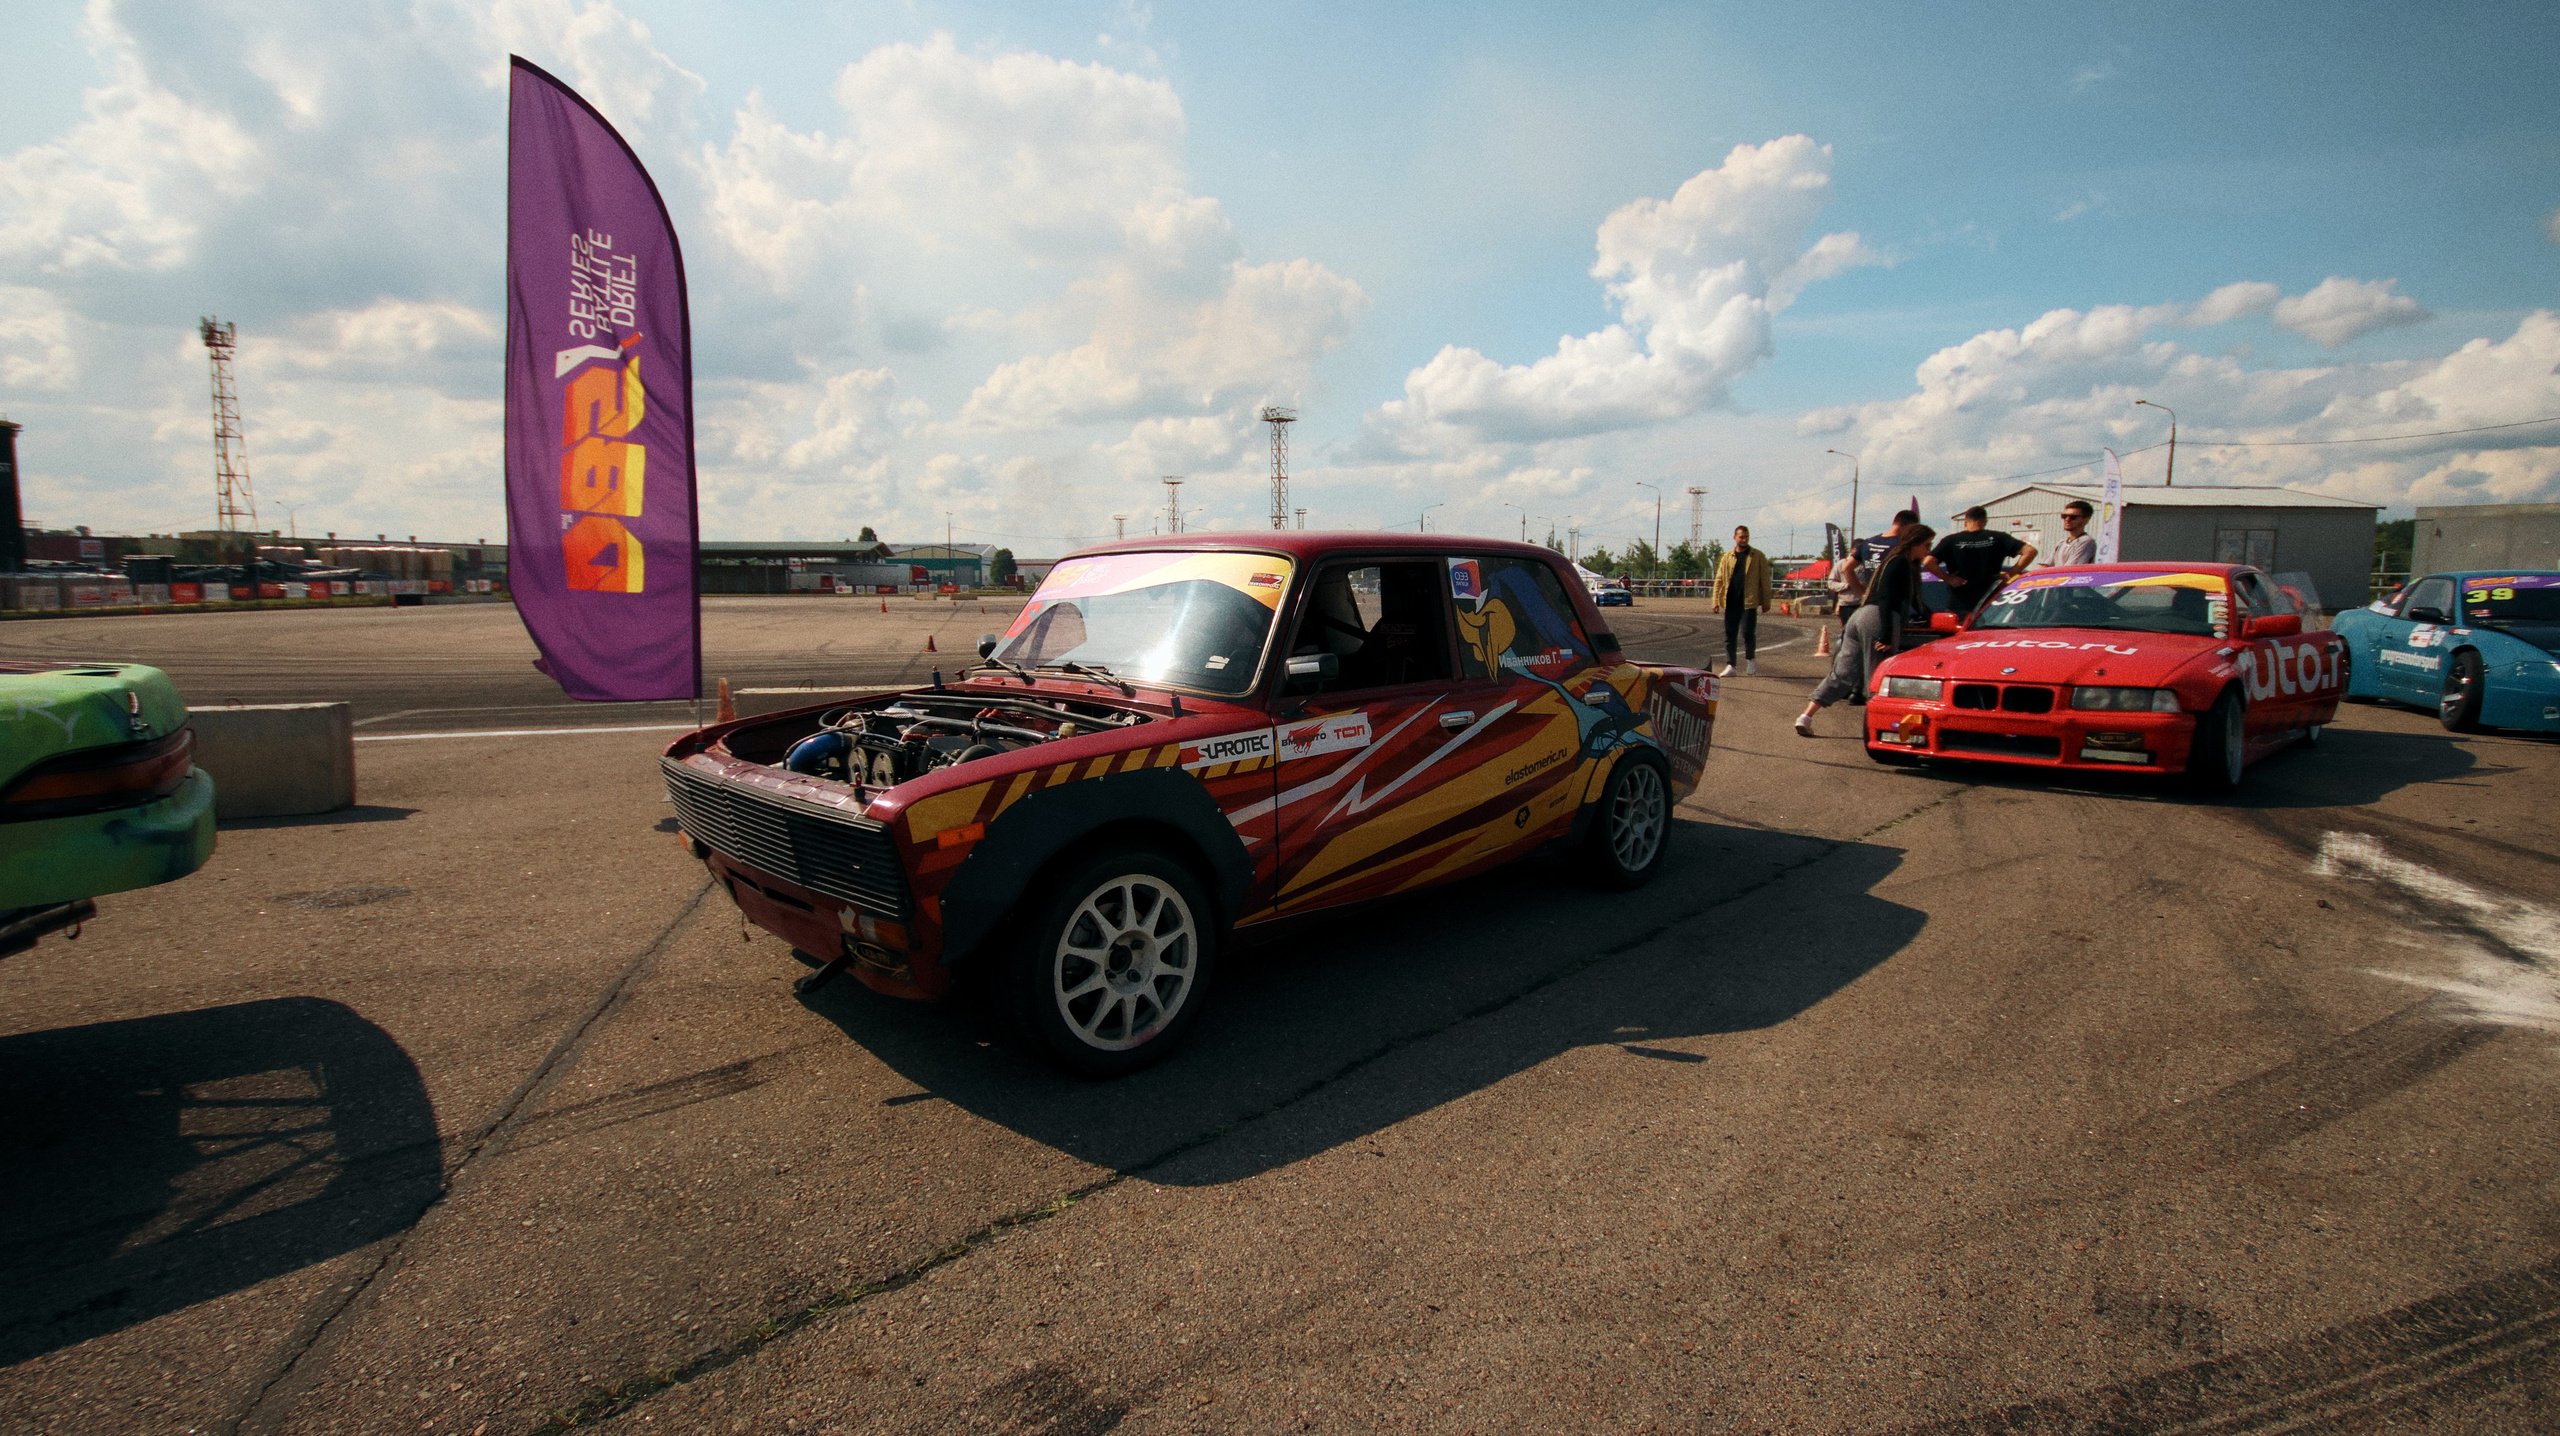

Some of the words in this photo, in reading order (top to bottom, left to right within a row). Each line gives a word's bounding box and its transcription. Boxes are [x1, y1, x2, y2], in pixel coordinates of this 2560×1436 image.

[1991, 589, 2031, 607] 36
[2465, 587, 2515, 604] 39
[1955, 640, 2139, 655] auto.ru
[1498, 654, 1551, 668] Иванников
[1551, 651, 1561, 664] Г.
[1505, 747, 1568, 786] elastomeric.ru
